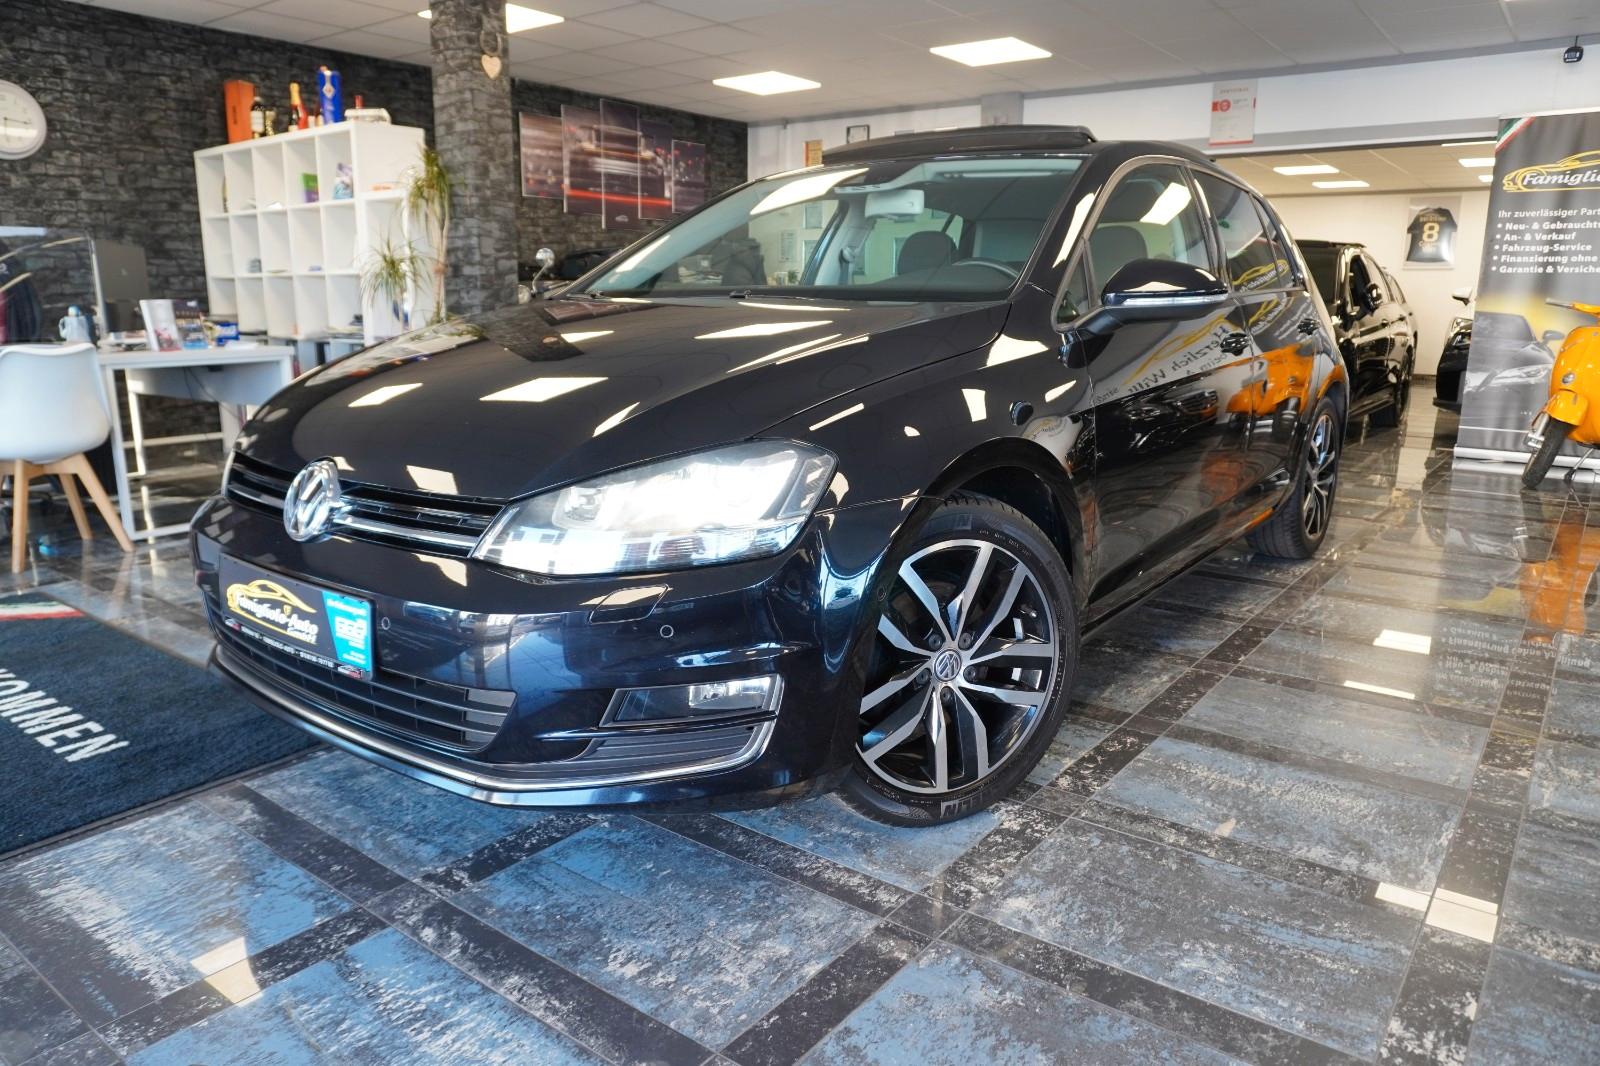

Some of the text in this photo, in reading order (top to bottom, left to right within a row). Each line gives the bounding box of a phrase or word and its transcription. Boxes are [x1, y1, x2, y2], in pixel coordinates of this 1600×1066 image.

[1498, 210, 1512, 218] Ihr
[1513, 209, 1578, 218] zuverlässiger
[1505, 222, 1529, 230] Neu-
[1532, 222, 1540, 230] &
[1422, 222, 1440, 241] 8
[1503, 231, 1577, 241] An- & Verkauf
[1502, 243, 1592, 253] Fahrzeug-Service
[1500, 254, 1599, 264] Finanzierung ohne
[1499, 265, 1544, 274] Garantie
[1545, 265, 1554, 273] &
